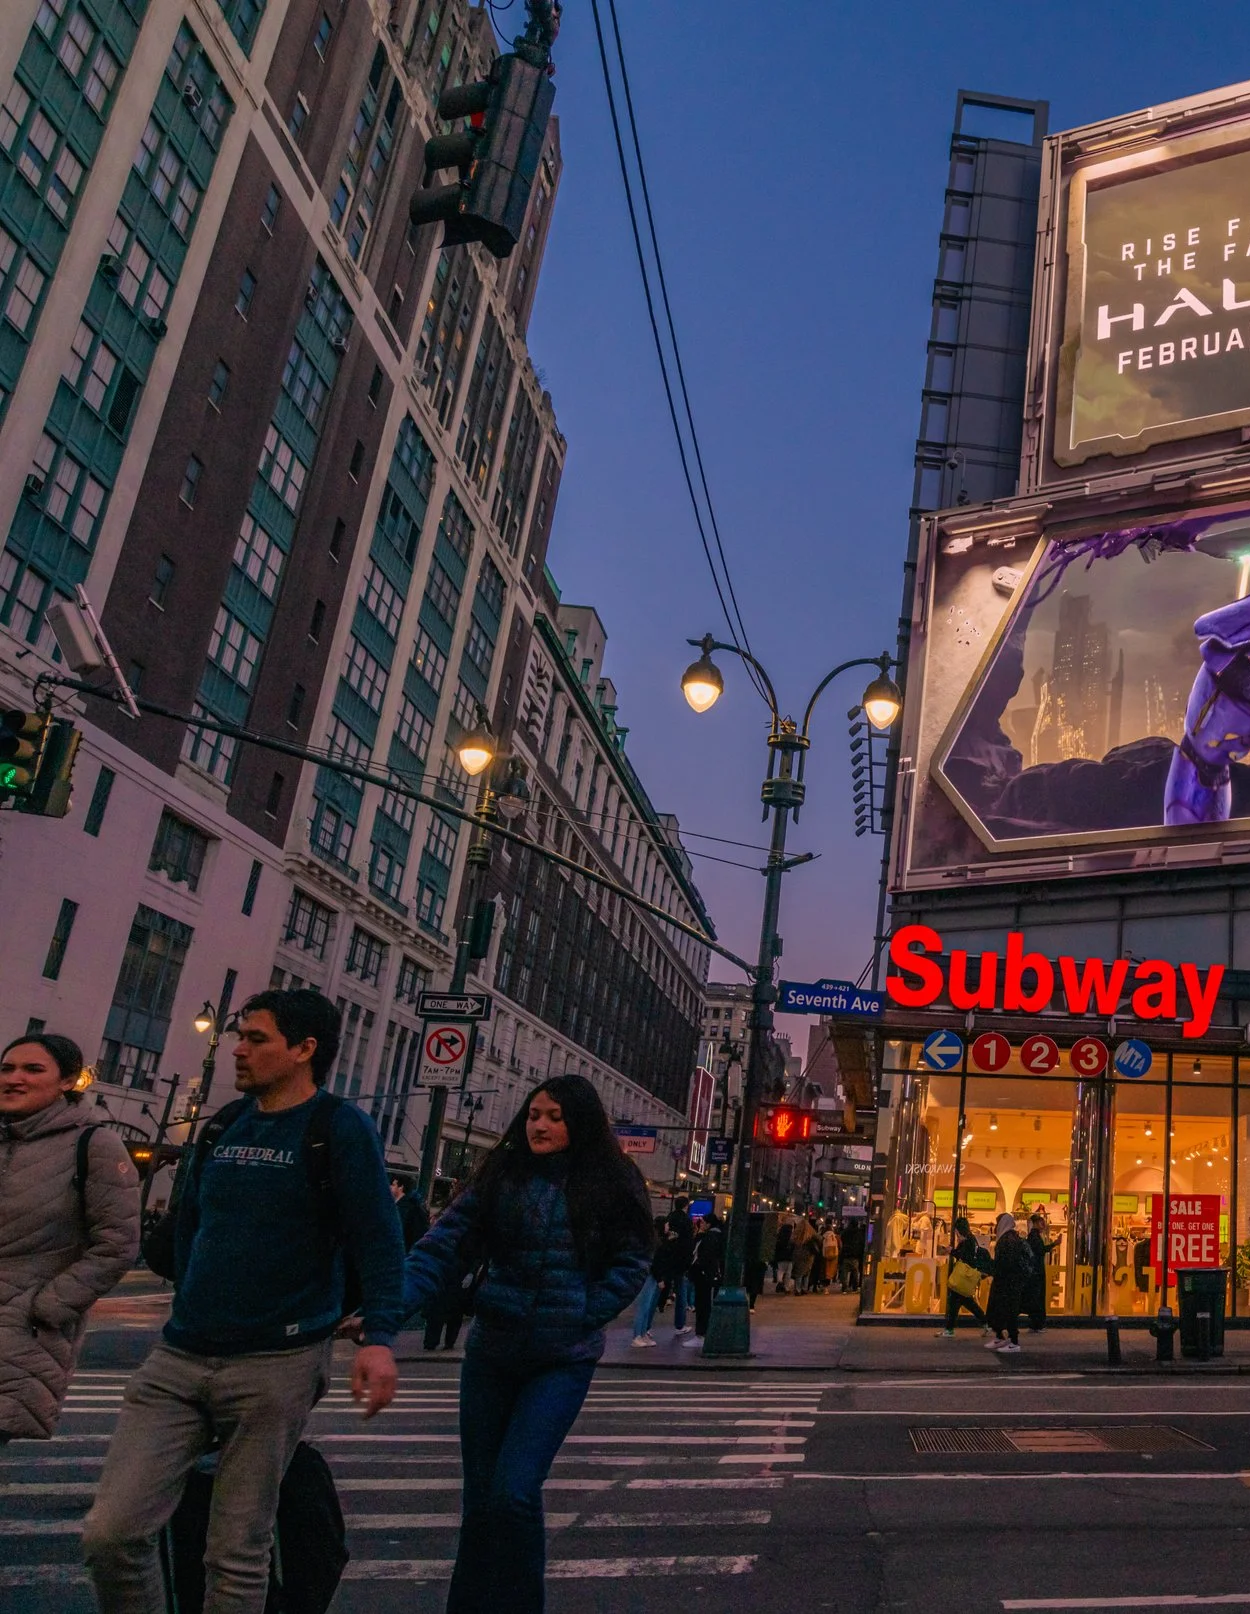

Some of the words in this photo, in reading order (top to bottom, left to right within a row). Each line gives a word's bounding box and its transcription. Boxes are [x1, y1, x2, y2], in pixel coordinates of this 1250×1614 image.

[1121, 227, 1200, 261] RISE
[1134, 252, 1196, 281] THE
[886, 924, 1226, 1039] Subway
[430, 1001, 448, 1009] ONE
[456, 1001, 476, 1009] WAY
[788, 990, 847, 1009] Seventh
[851, 996, 880, 1012] Ave
[983, 1039, 997, 1066] 1
[1030, 1042, 1050, 1069] 2
[1079, 1043, 1100, 1070] 3
[1115, 1040, 1144, 1072] MTA
[816, 1124, 842, 1133] Subway
[627, 1140, 648, 1148] ONLY
[213, 1145, 294, 1165] CATHEDRAL
[854, 1163, 866, 1171] OLD
[1170, 1200, 1202, 1215] SALE
[1188, 1222, 1200, 1231] GET
[1202, 1222, 1215, 1231] ONE
